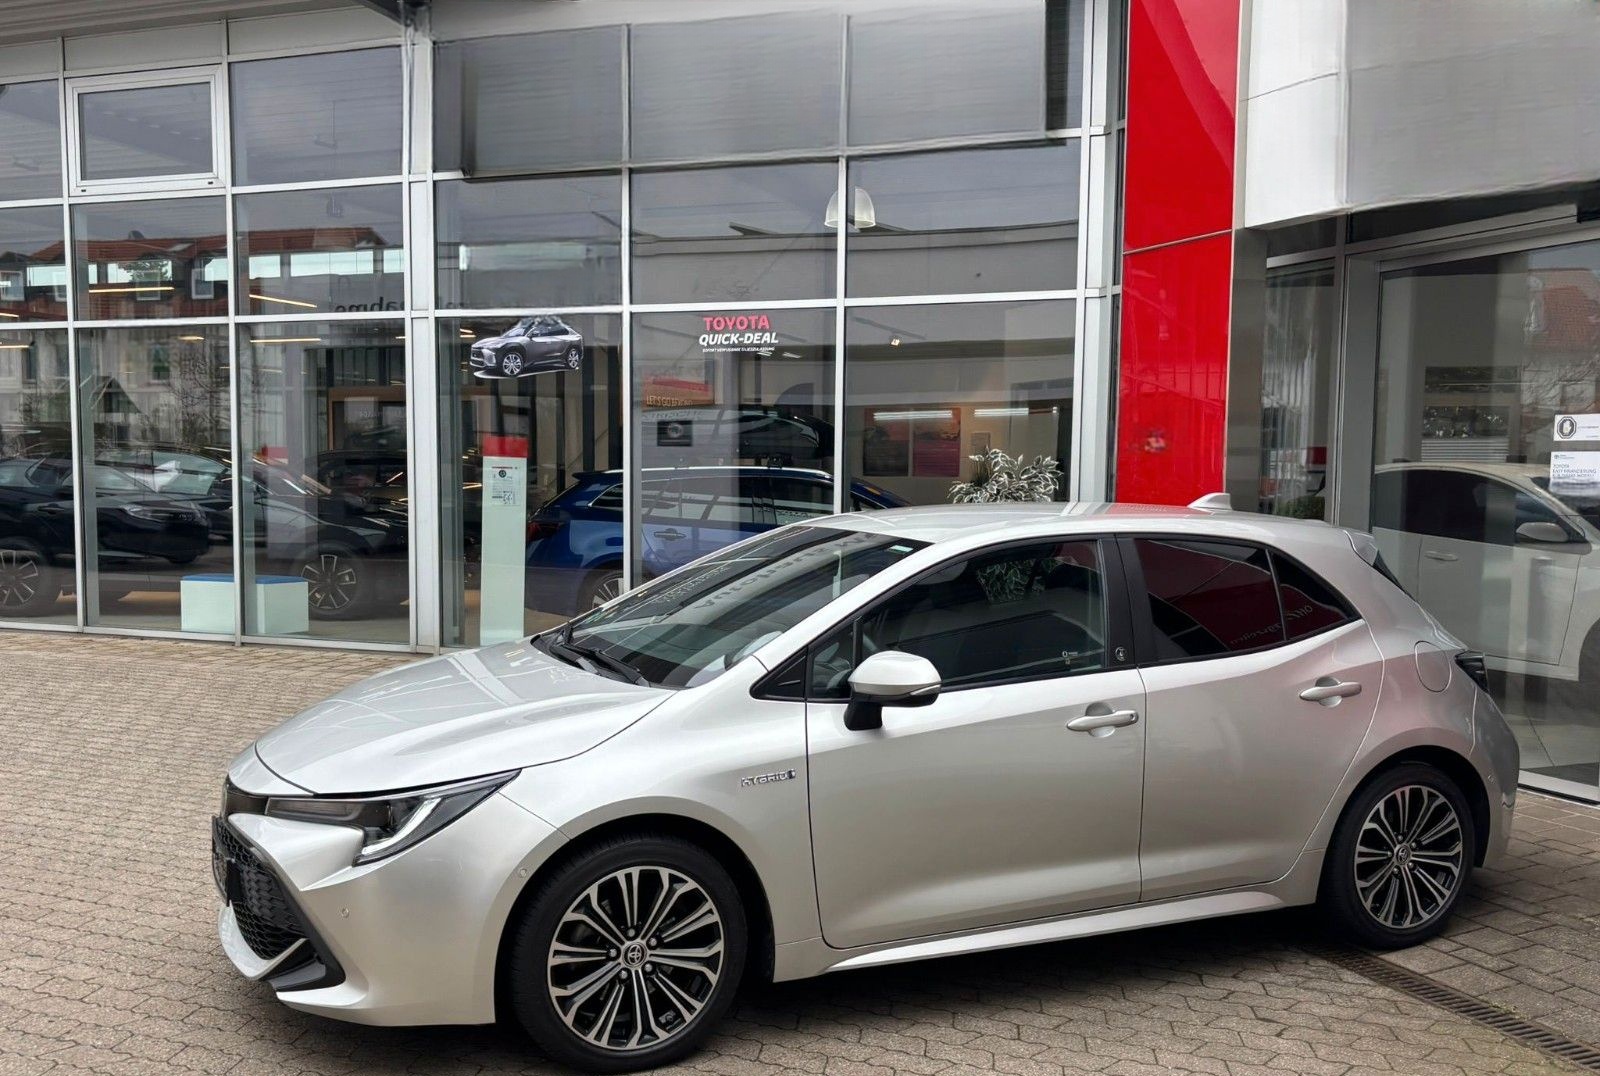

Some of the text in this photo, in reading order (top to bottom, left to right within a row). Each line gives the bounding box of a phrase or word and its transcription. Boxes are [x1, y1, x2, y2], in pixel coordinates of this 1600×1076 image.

[703, 314, 770, 331] TOYOTA
[698, 332, 779, 347] QUICK-DEAL
[741, 771, 788, 787] HYBRID
